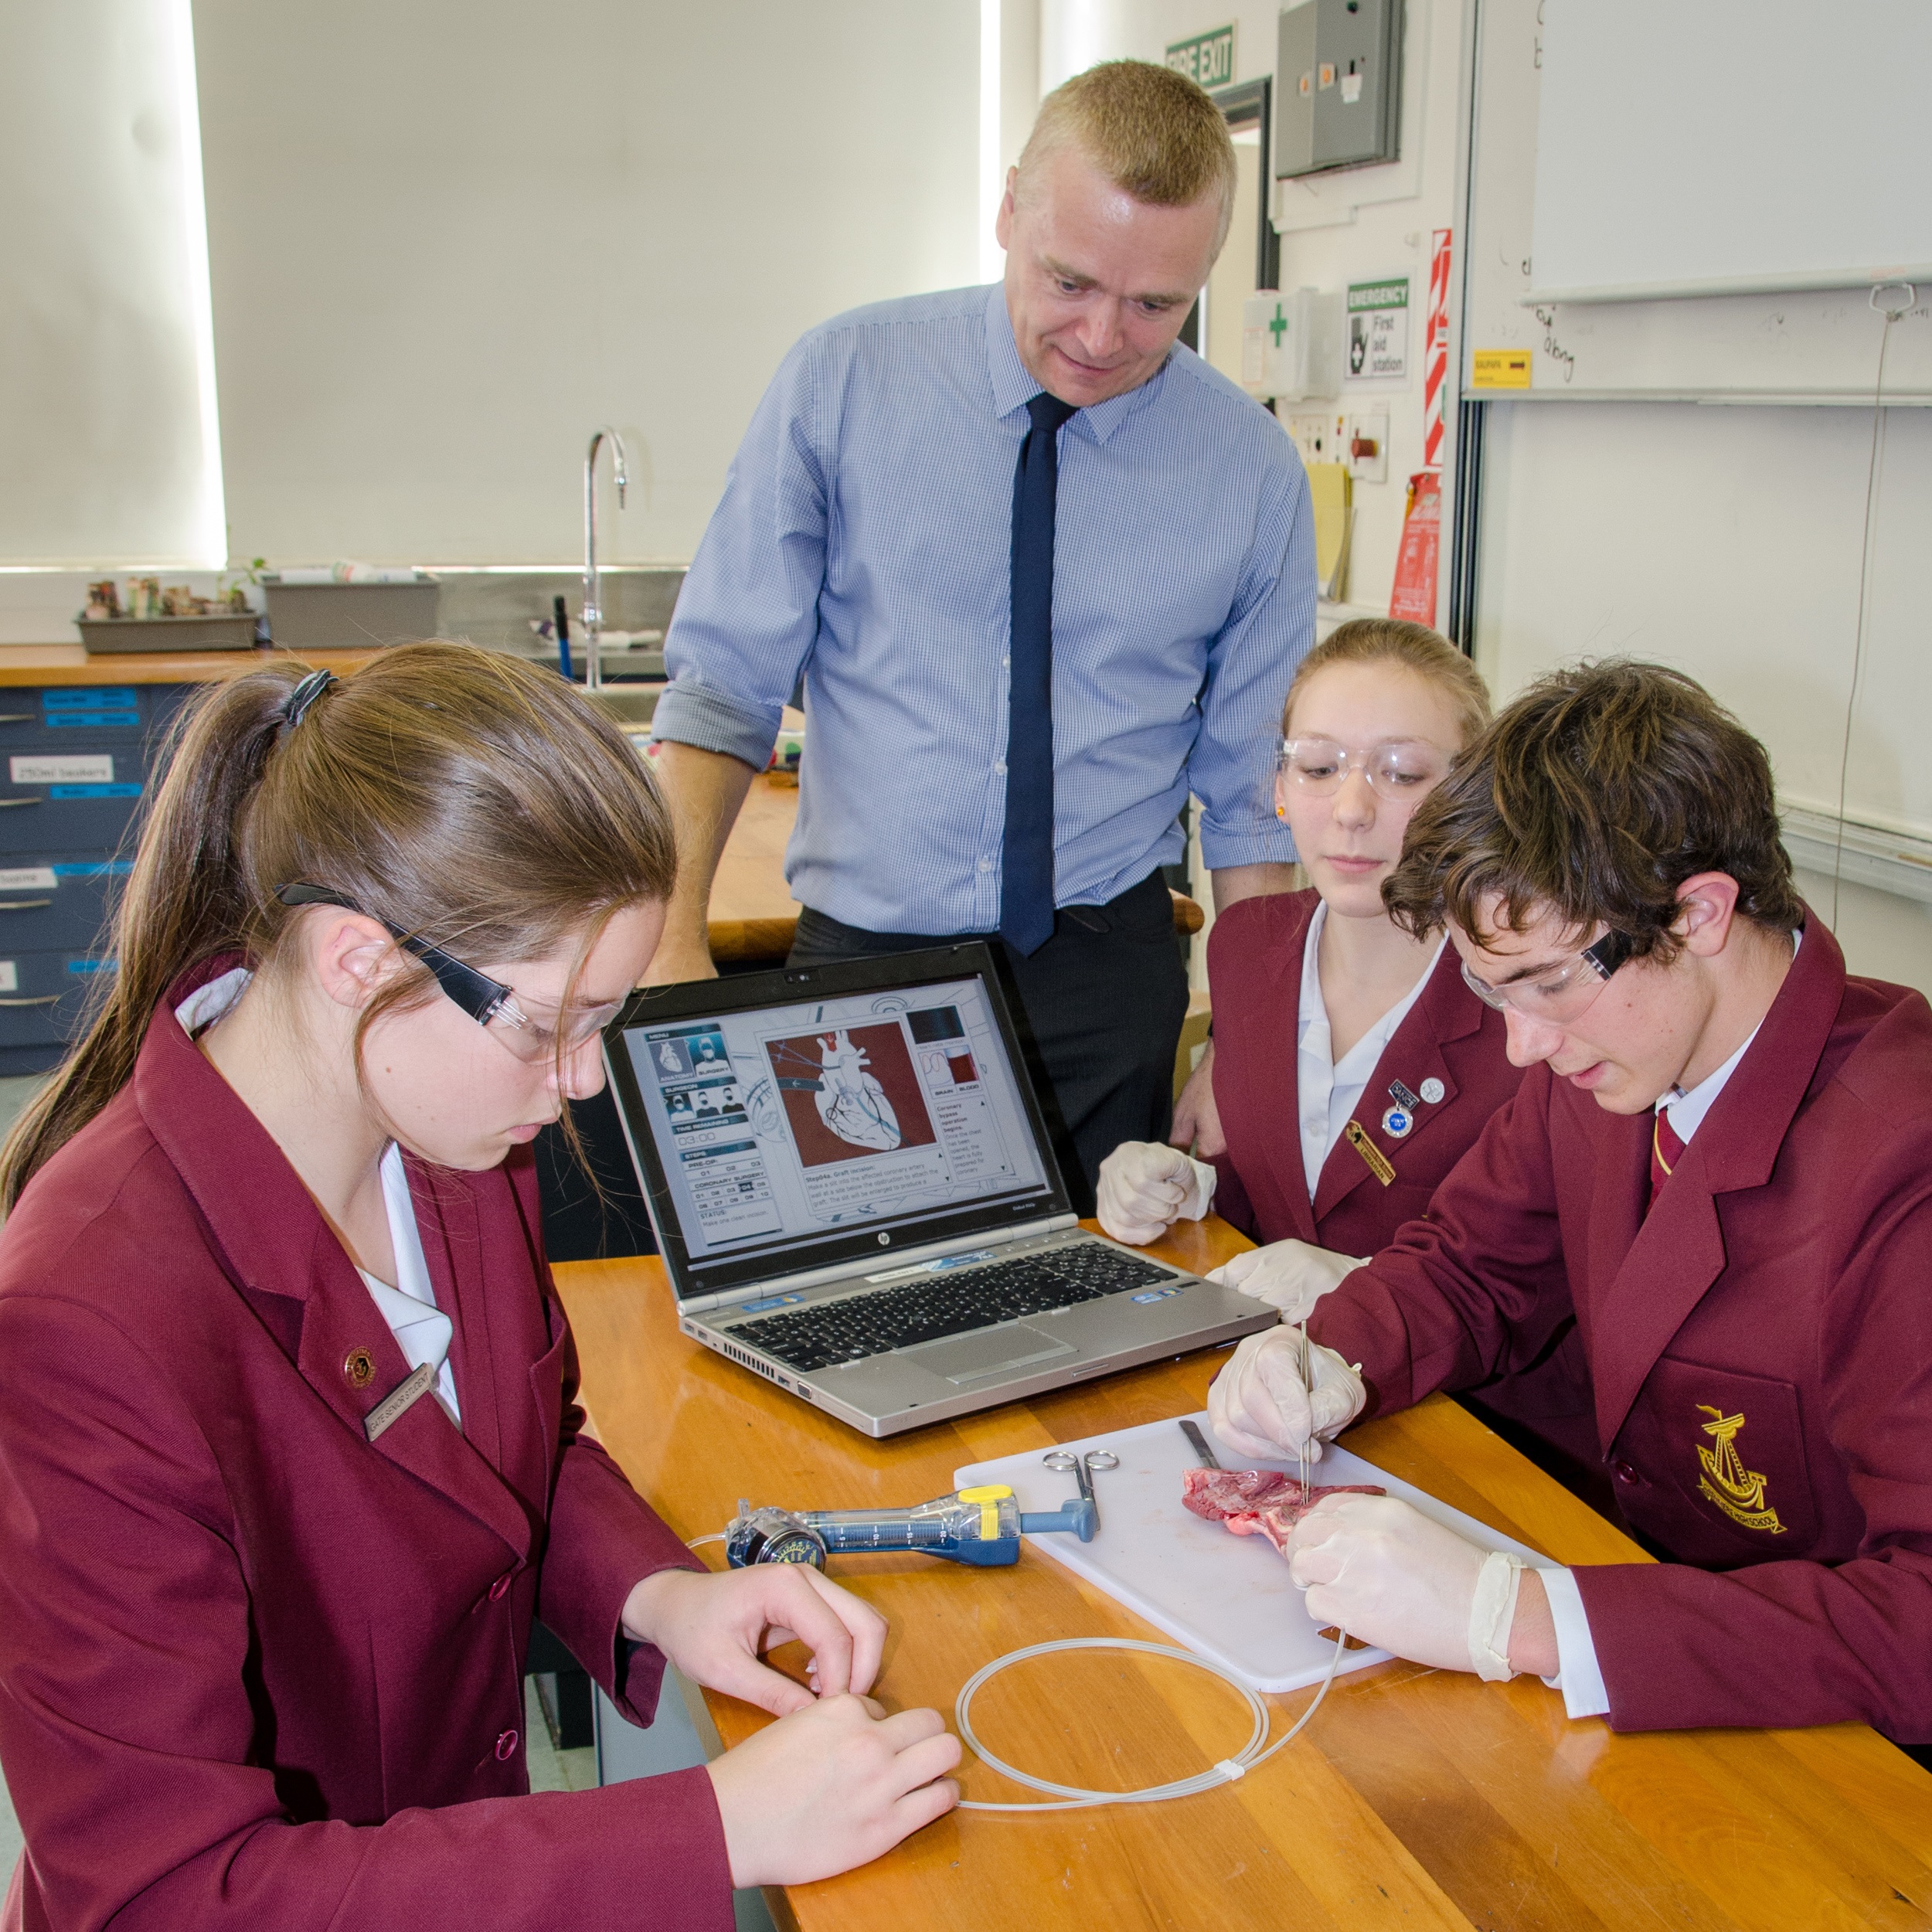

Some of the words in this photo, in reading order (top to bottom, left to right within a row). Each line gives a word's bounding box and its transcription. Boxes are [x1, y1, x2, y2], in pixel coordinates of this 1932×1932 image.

[1199, 33, 1230, 82] EXIT
[1349, 286, 1406, 307] EMERGENCY
[1374, 315, 1394, 331] First
[1373, 335, 1386, 351] aid
[1373, 357, 1403, 372] station
[659, 1072, 695, 1081] ANATOMY
[698, 1066, 729, 1076] SURGERY
[665, 1083, 698, 1094] SURGEON
[958, 1083, 979, 1092] BLOOD
[1392, 1084, 1416, 1107] DANCE
[937, 1104, 962, 1112] Coronary
[693, 1118, 729, 1129] REMAINING
[941, 1117, 968, 1126] operation
[679, 1131, 716, 1145] 03:00
[1360, 1148, 1384, 1179] LIBRARIAN
[695, 1178, 732, 1189] CORONARY
[733, 1172, 764, 1181] SURGERY
[834, 1168, 849, 1178] Graft
[371, 1414, 386, 1431] GATE
[386, 1394, 406, 1416] SENIOR
[406, 1372, 427, 1399] STUDENT
[1747, 1516, 1776, 1527] SCHOOL
